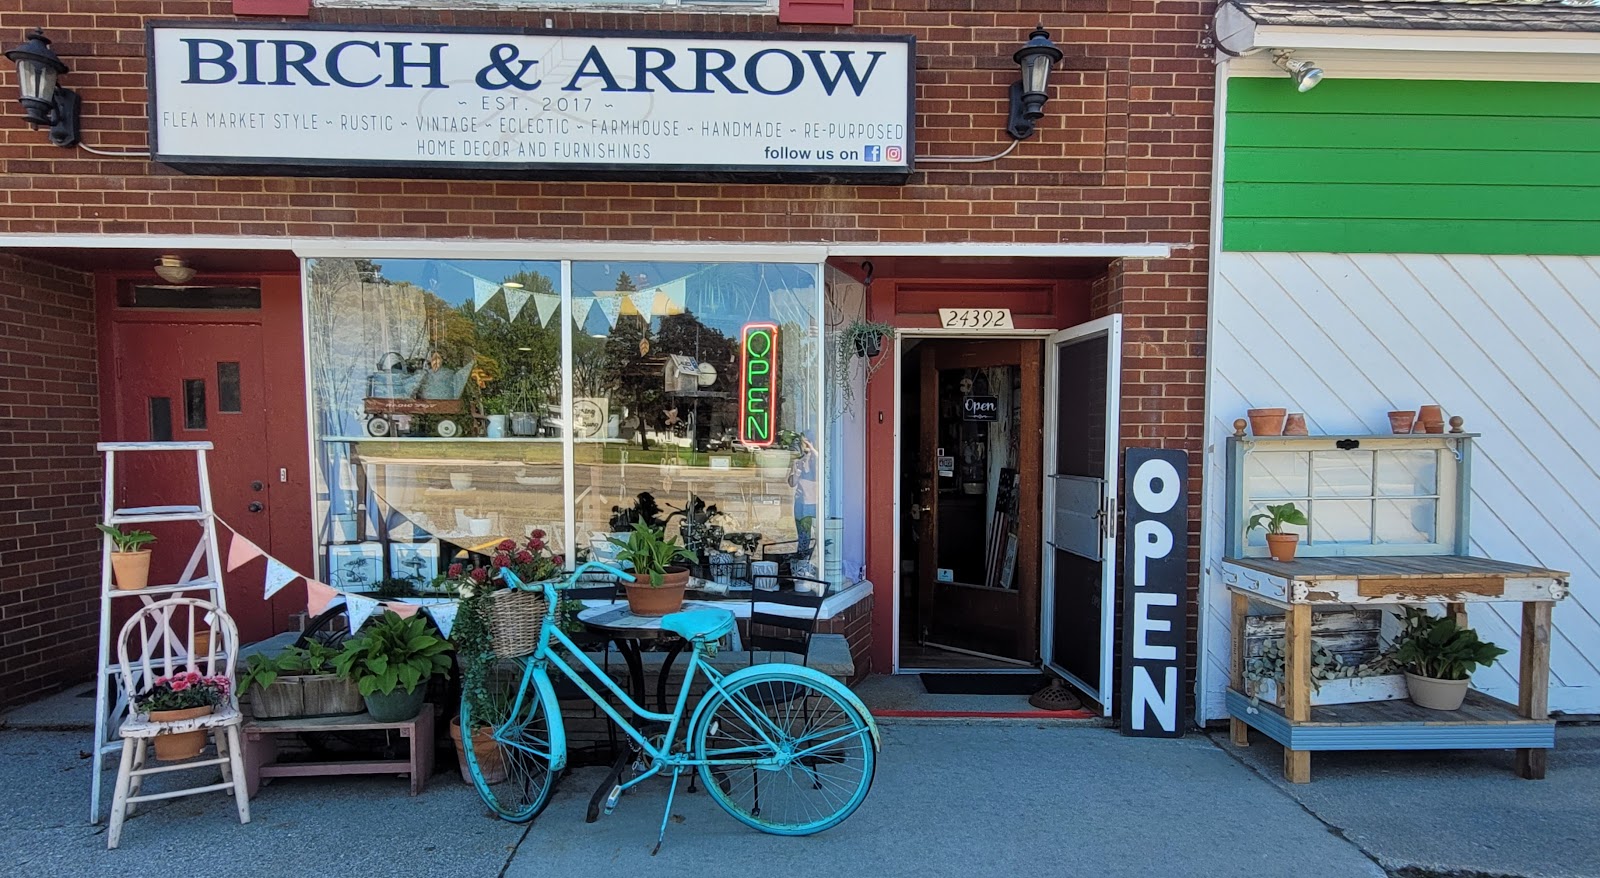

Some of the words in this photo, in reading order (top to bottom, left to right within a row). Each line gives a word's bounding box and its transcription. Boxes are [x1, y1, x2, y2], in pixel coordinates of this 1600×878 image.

[179, 38, 450, 88] BIRCH
[475, 43, 542, 91] &
[561, 45, 887, 97] ARROW
[481, 95, 529, 111] EST.
[542, 97, 592, 113] 2017
[163, 111, 199, 128] FLEA
[206, 112, 266, 129] MARKET
[273, 114, 318, 130] STYLE
[340, 115, 393, 132] RUSTIC
[415, 116, 478, 133] VINTAGE
[500, 117, 570, 135] ECLECTIC
[591, 119, 680, 137] FARMHOUSE
[701, 121, 782, 138] HANDMADE
[804, 122, 904, 140] RE-PURPOSED
[417, 139, 456, 156] HOME
[463, 140, 509, 157] DECOR
[518, 141, 546, 158] AND
[553, 142, 651, 160] FURNISHINGS
[764, 146, 811, 160] follow
[816, 149, 835, 160] us
[839, 150, 859, 161] on
[946, 310, 1005, 327] 24392
[747, 331, 771, 439] OPEN
[965, 398, 997, 414] Open
[1131, 458, 1181, 732] OPEN
